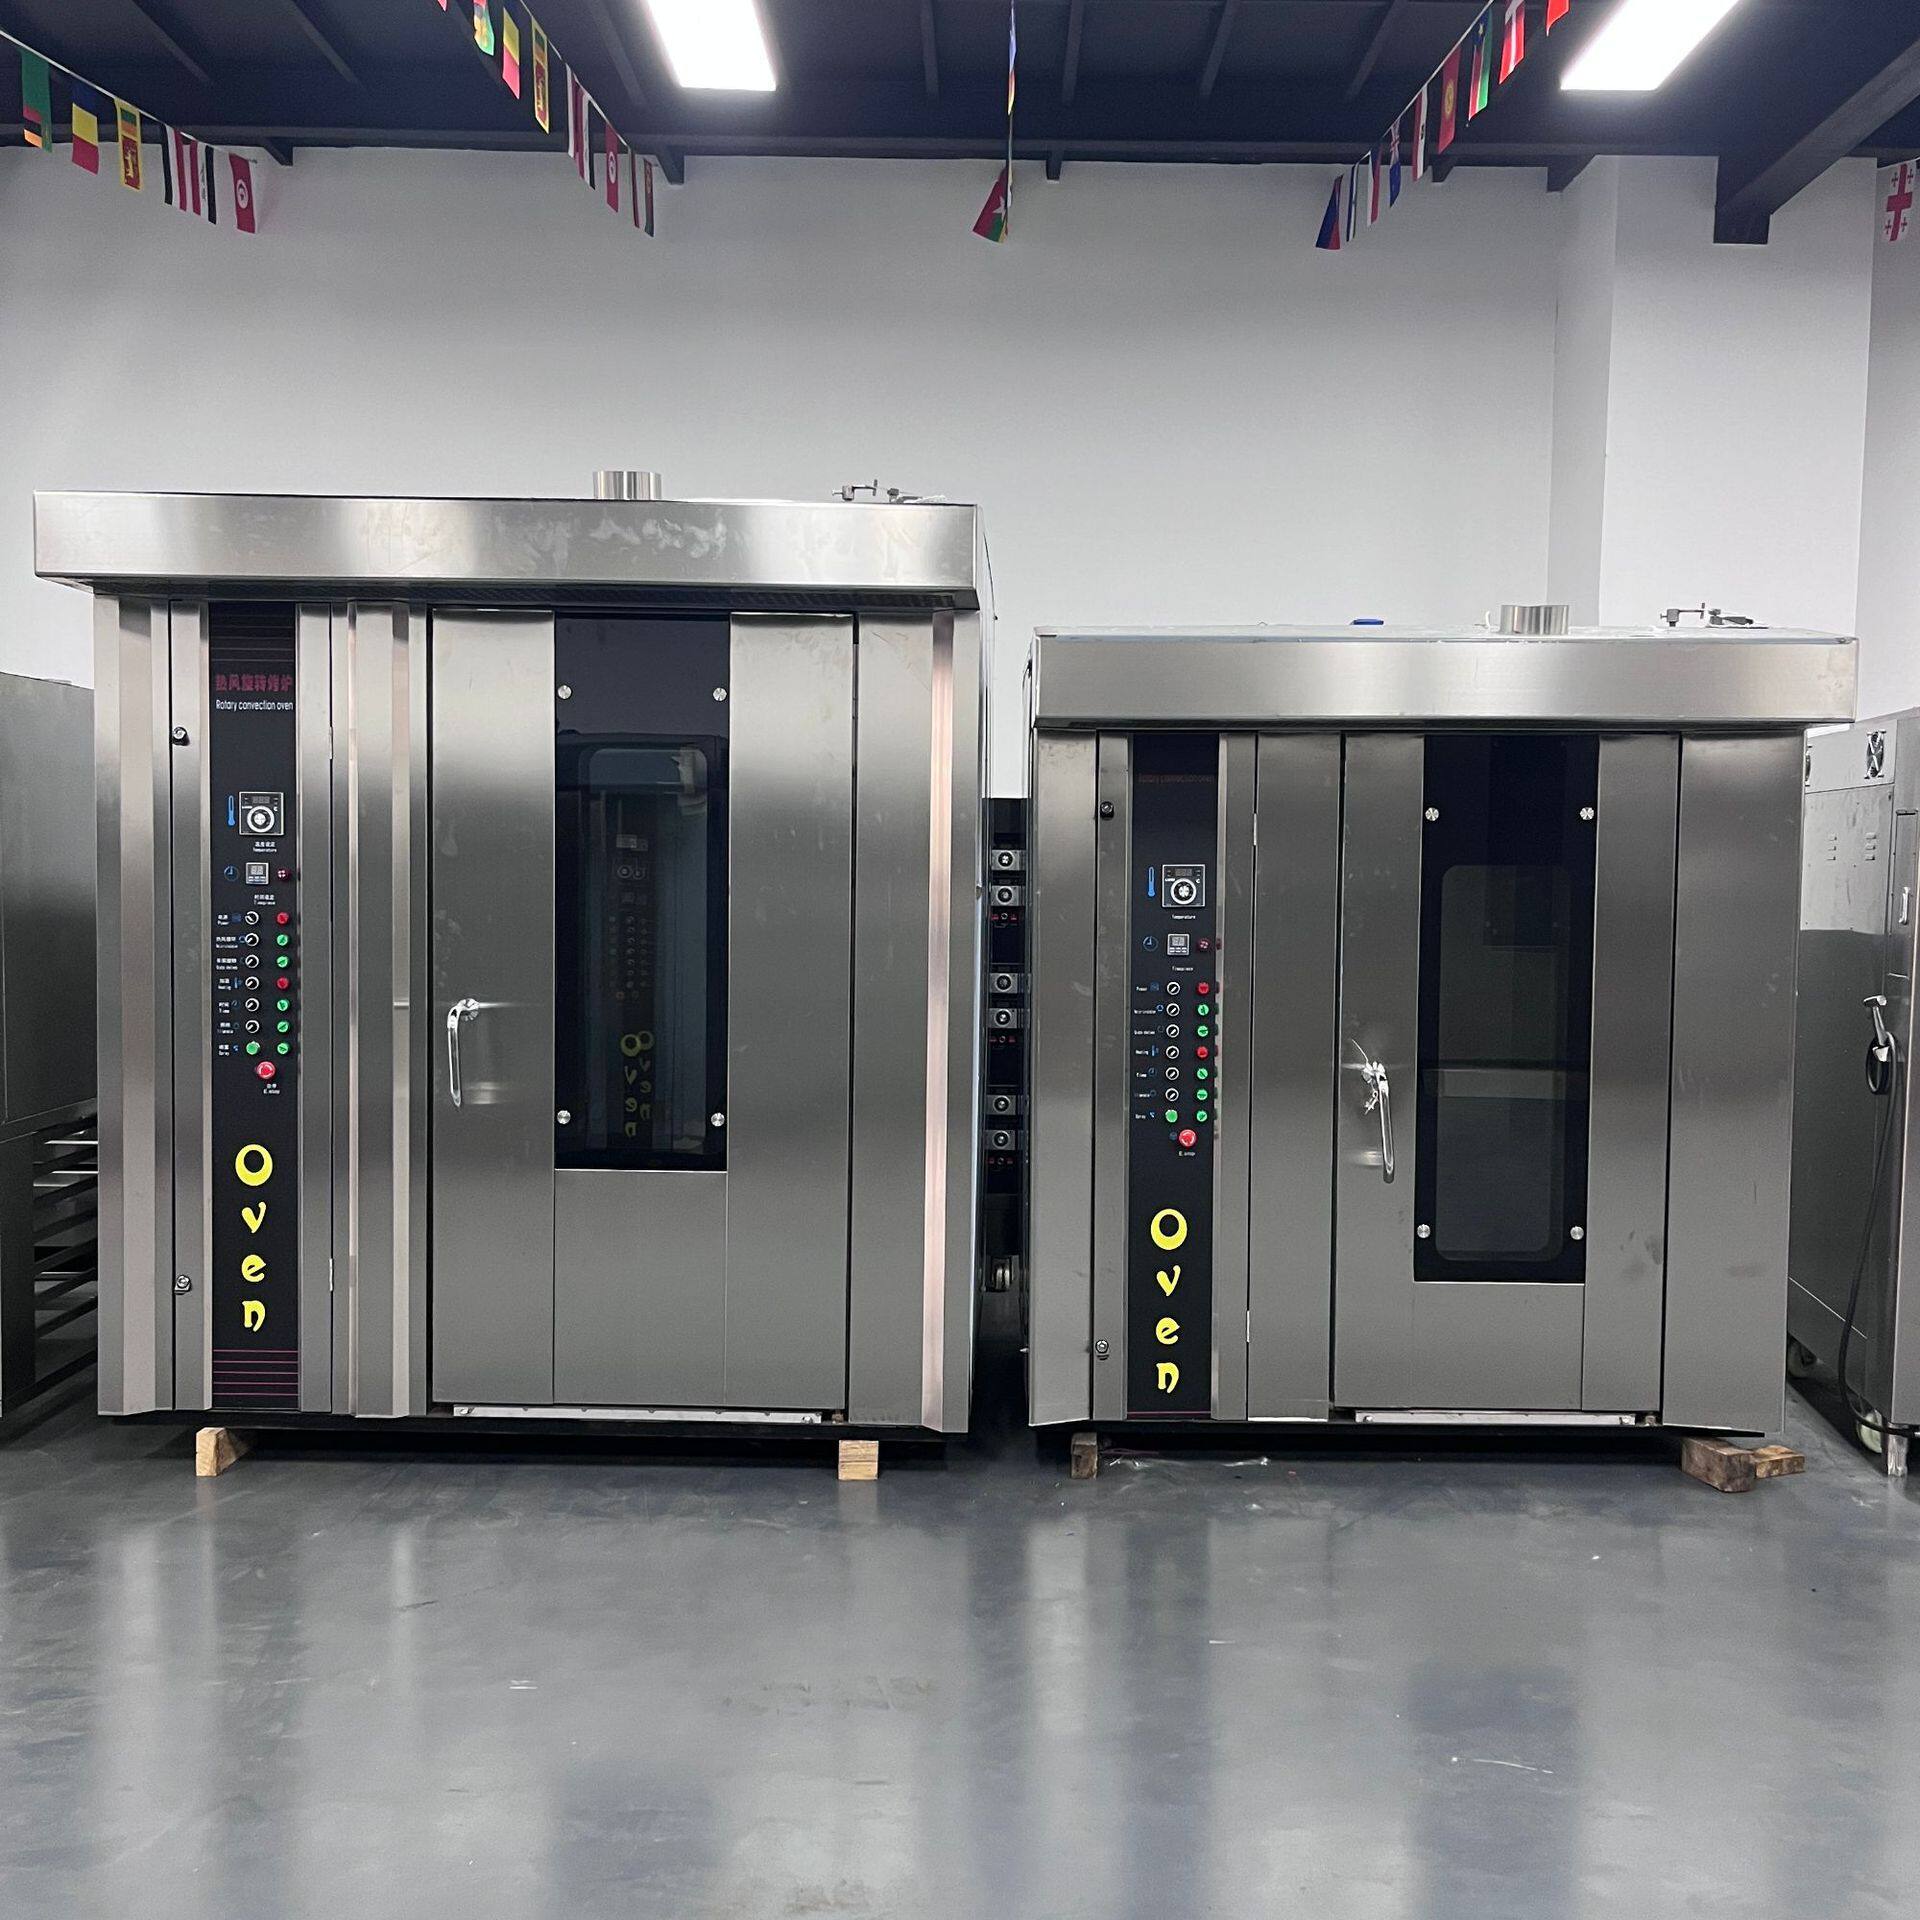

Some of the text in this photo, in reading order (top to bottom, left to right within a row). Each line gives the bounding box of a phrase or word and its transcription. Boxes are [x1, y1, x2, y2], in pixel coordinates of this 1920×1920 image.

[215, 699, 294, 712] Rotary convection oven
[235, 1143, 273, 1332] Oven
[1150, 1208, 1188, 1394] Oven
